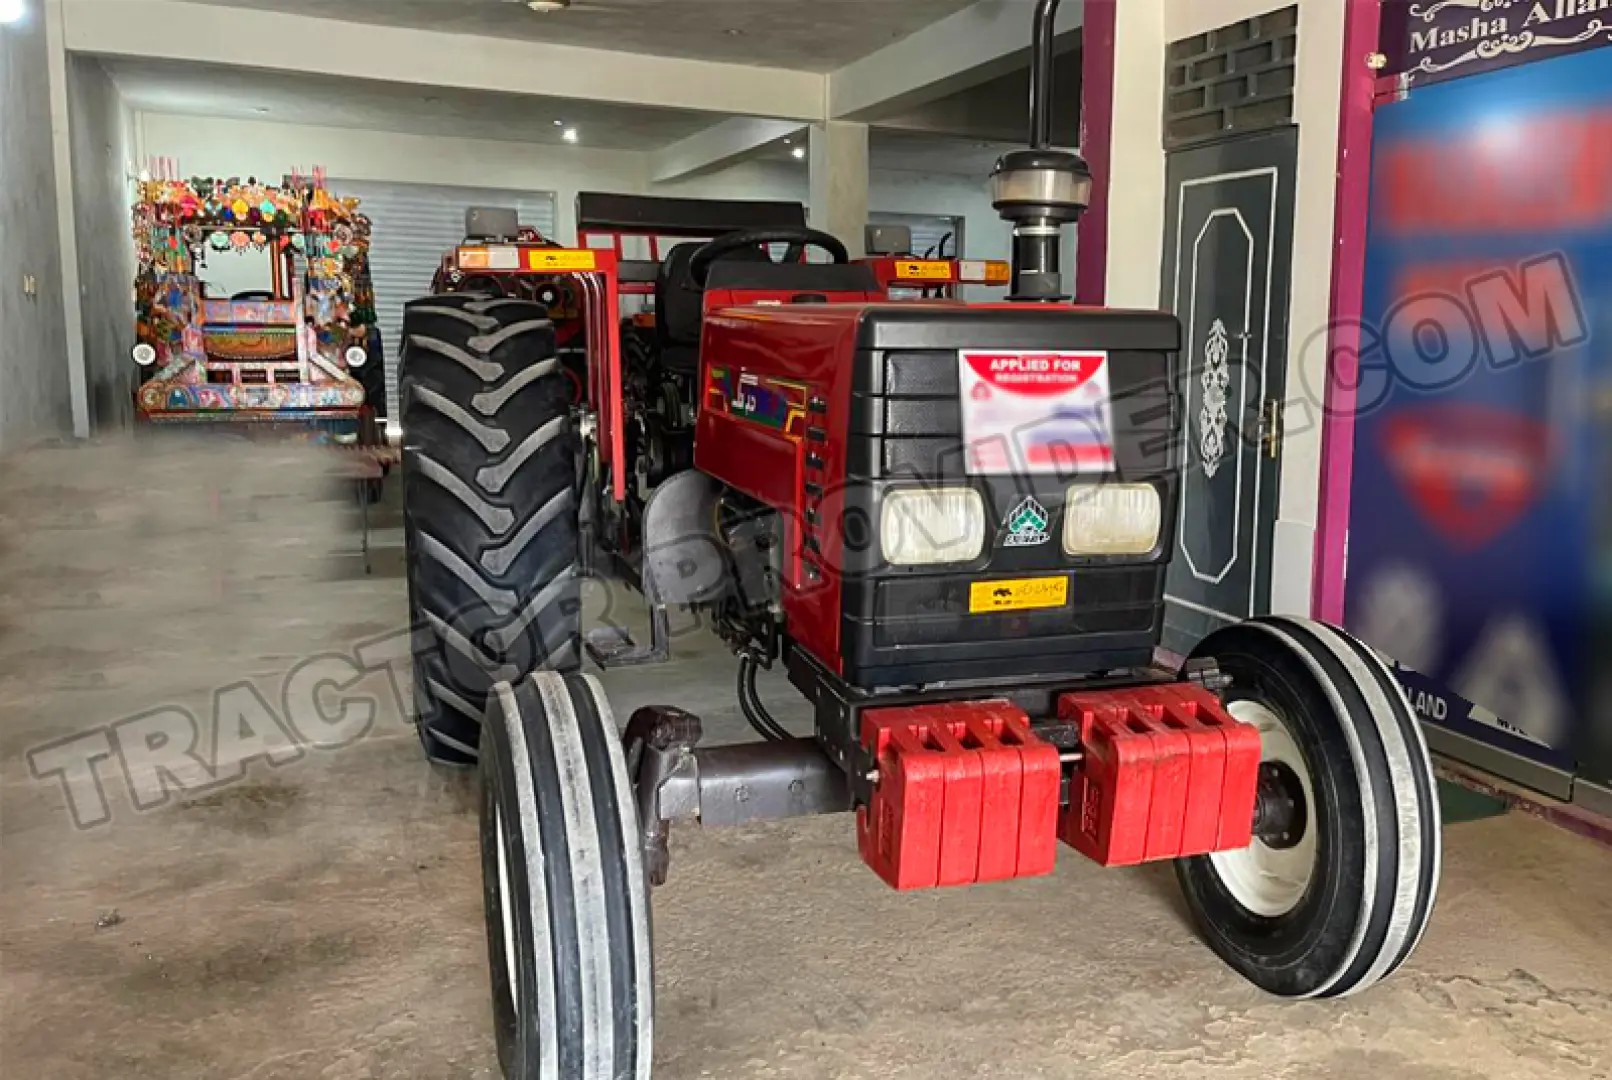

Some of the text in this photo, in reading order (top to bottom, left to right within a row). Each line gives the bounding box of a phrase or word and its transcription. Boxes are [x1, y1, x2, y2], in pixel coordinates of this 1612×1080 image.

[1408, 17, 1509, 54] Masha
[989, 358, 1081, 372] APPLIED FOR
[994, 373, 1078, 383] REGISTRATION
